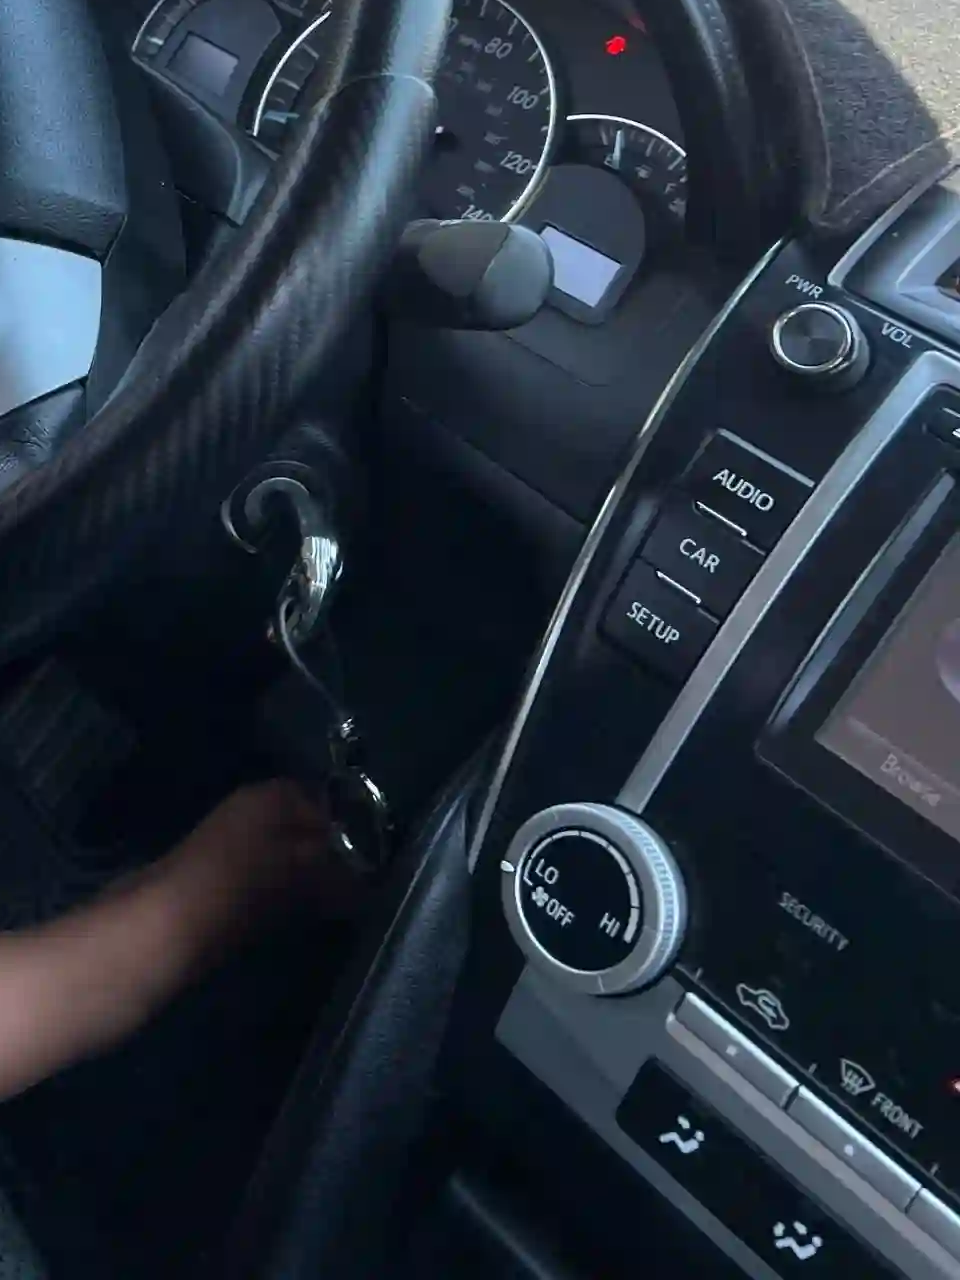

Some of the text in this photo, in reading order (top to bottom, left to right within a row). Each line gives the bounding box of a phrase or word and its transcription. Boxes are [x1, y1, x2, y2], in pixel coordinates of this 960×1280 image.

[484, 37, 513, 59] 80
[506, 86, 539, 110] 100
[499, 151, 534, 174] 120
[785, 274, 823, 299] PWR
[881, 321, 913, 349] VOL
[712, 468, 775, 512] AUDIO
[679, 538, 721, 574] CAR
[626, 601, 680, 644] SETUP
[535, 858, 559, 885] LO
[546, 898, 576, 927] OFF
[599, 911, 620, 939] HI
[778, 891, 850, 952] SECURITY
[871, 1091, 924, 1139] FRONT
